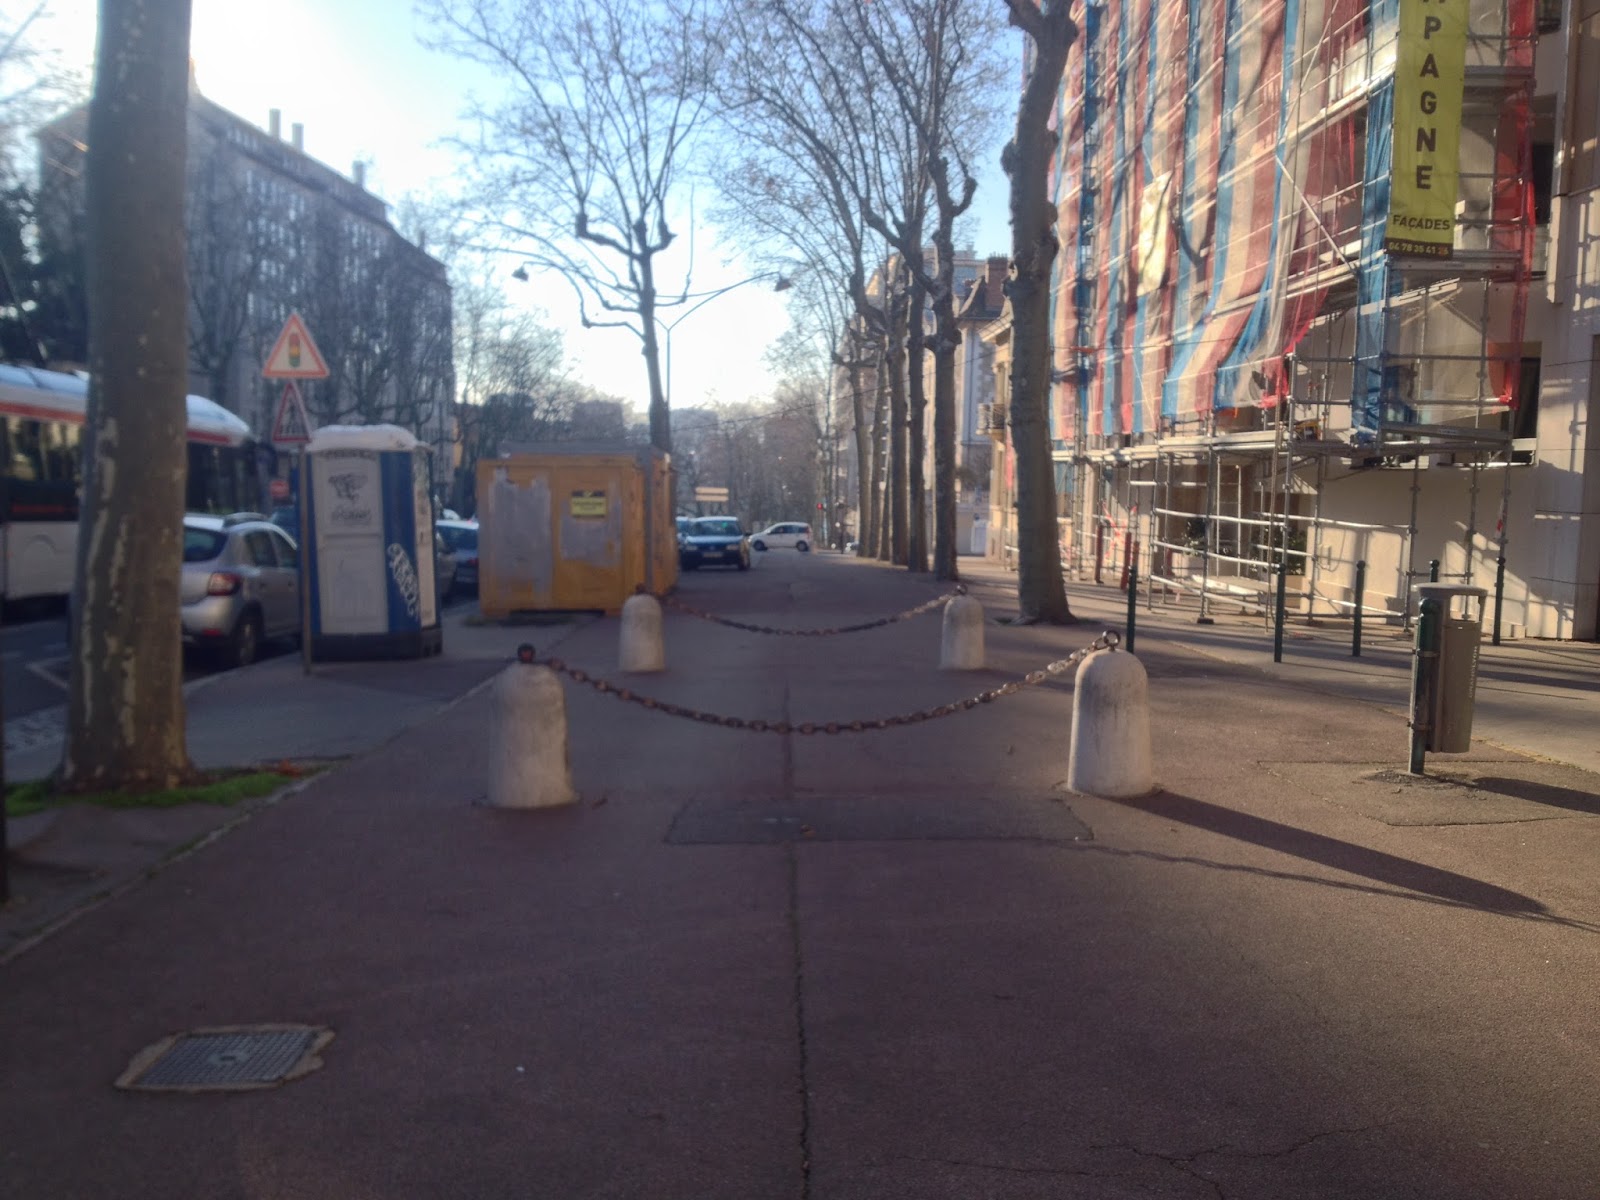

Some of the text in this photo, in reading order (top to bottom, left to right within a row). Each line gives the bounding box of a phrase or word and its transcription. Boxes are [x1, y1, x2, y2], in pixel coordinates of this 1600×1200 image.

[1416, 0, 1446, 190] PAGNE
[1393, 214, 1451, 231] FAÇADES
[1388, 242, 1400, 251] 04
[1401, 243, 1413, 252] 78
[1425, 246, 1436, 255] 41
